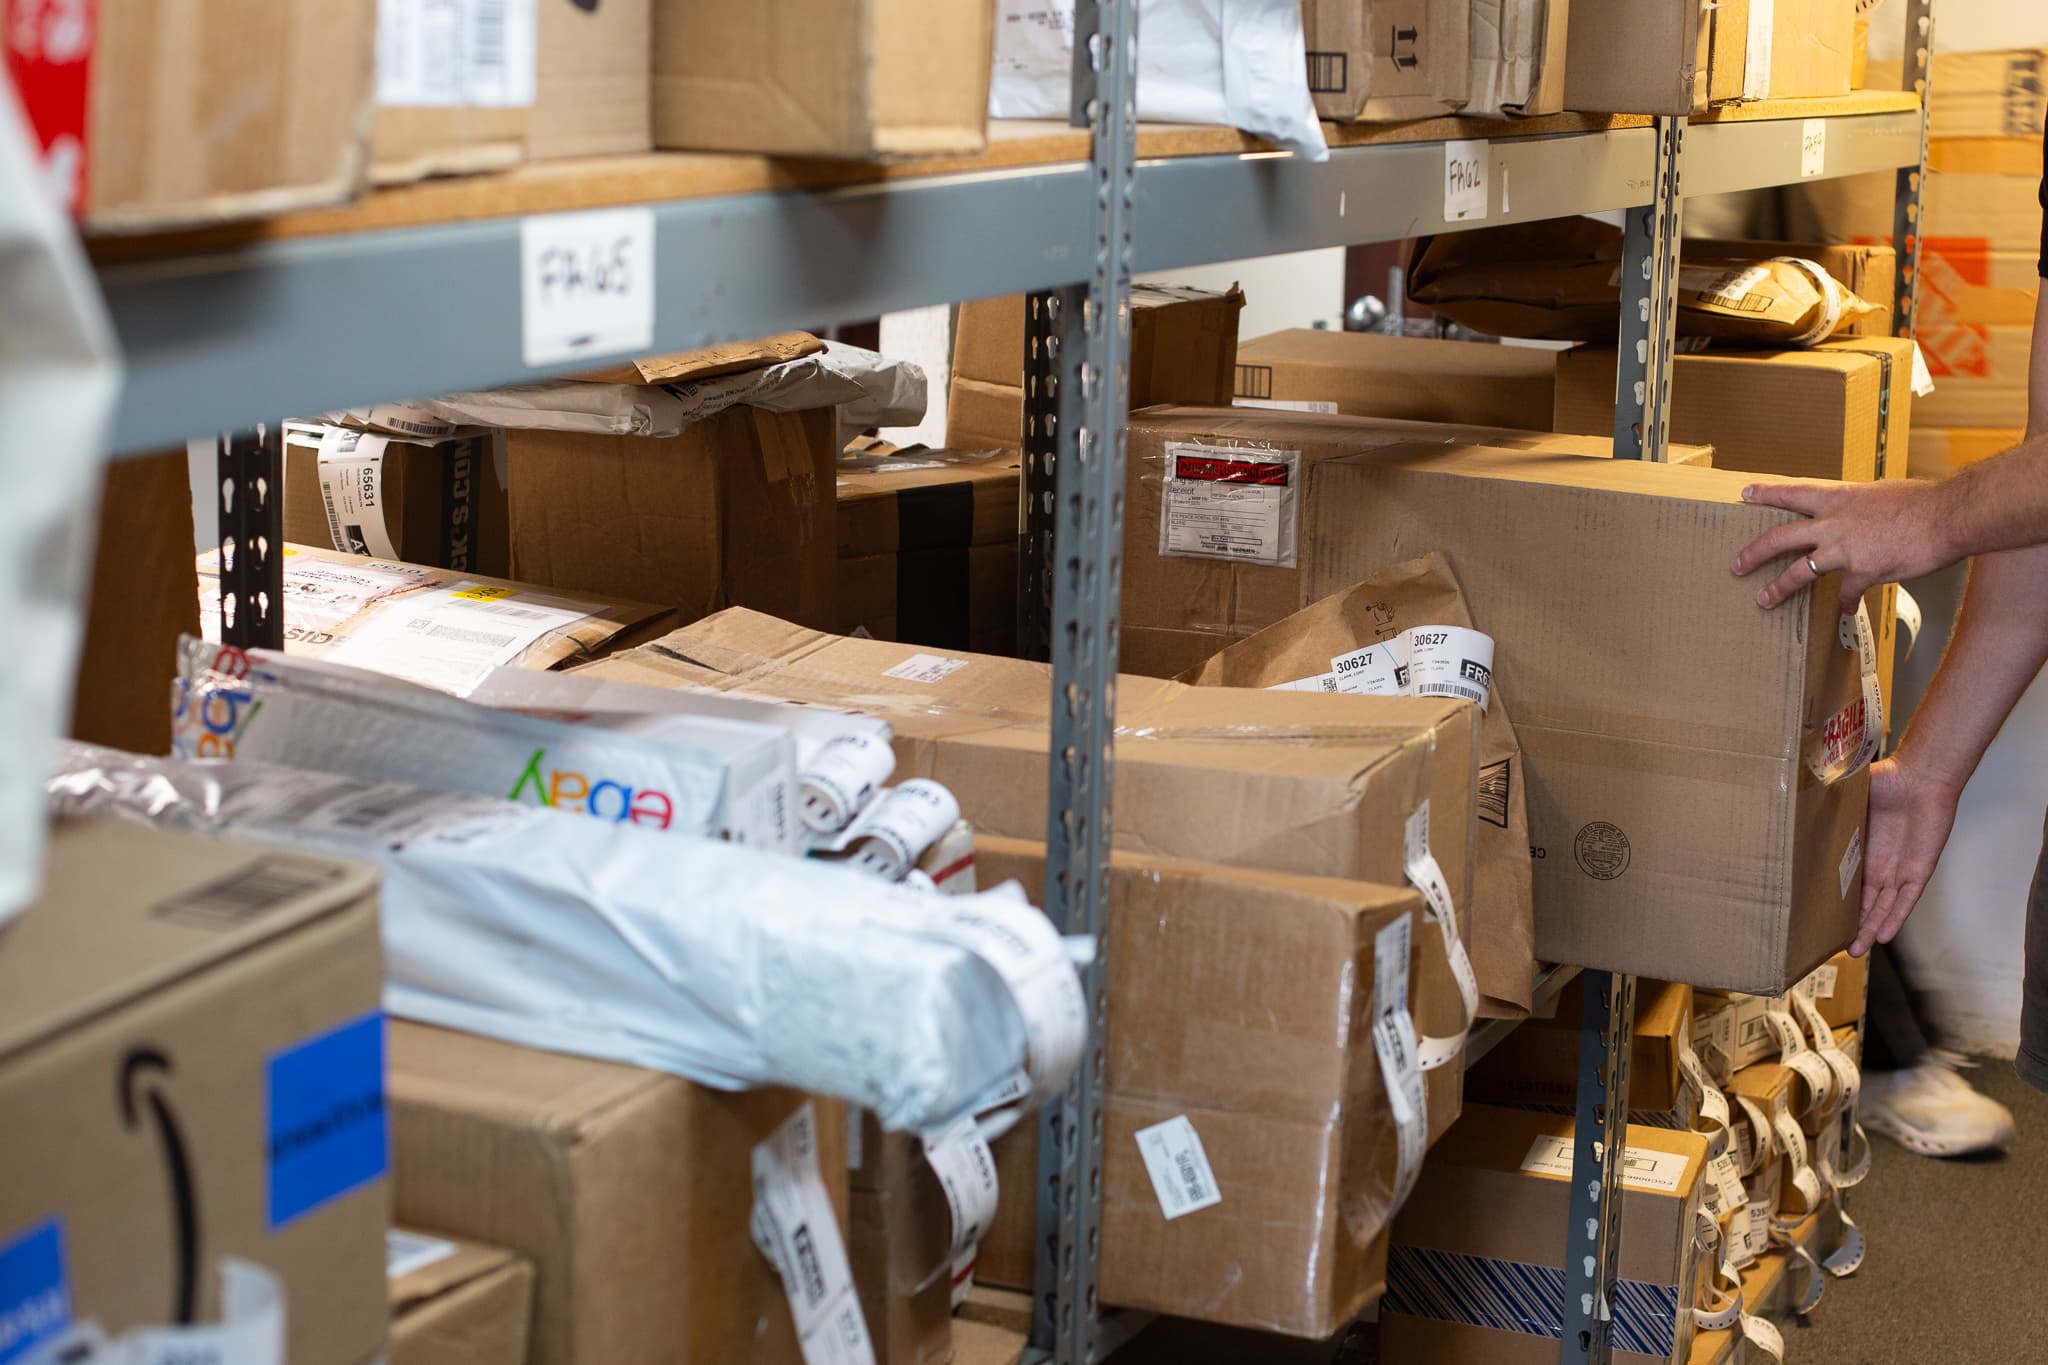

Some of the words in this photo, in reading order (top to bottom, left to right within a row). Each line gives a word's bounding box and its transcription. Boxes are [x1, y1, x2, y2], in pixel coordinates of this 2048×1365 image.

[362, 467, 376, 508] 65631
[1414, 633, 1448, 647] 30627
[1336, 652, 1373, 674] 30627
[508, 746, 674, 831] ebay
